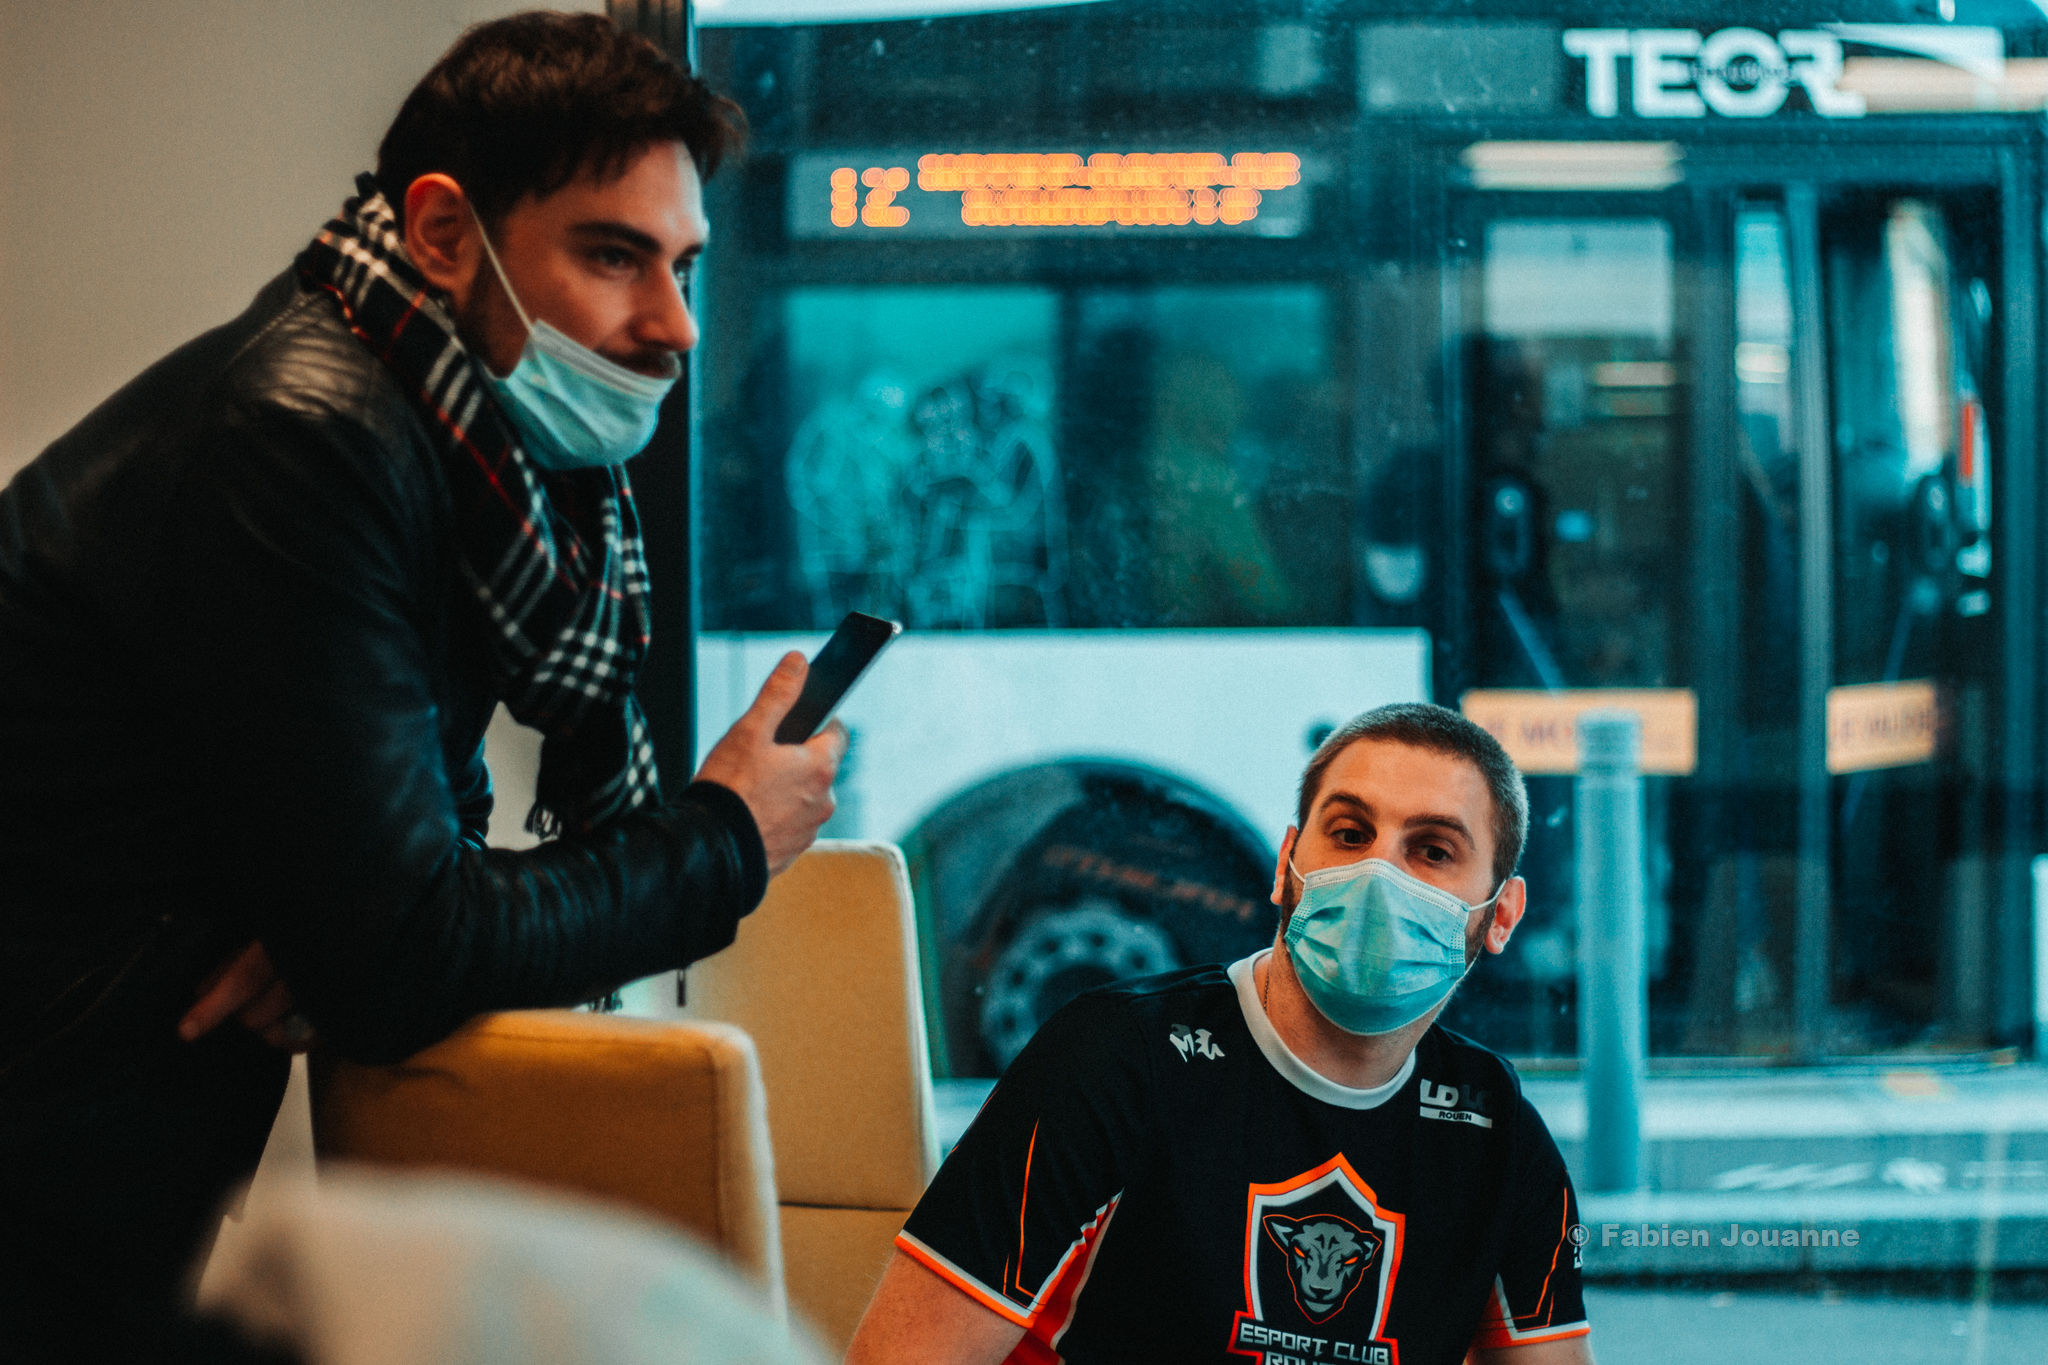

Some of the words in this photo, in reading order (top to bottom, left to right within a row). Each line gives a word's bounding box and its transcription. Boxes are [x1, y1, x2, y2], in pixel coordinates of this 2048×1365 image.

[1562, 27, 1868, 118] TEOR
[1438, 1111, 1473, 1121] ROUEN
[1239, 1322, 1329, 1357] ESPORT
[1333, 1341, 1391, 1365] CLUB
